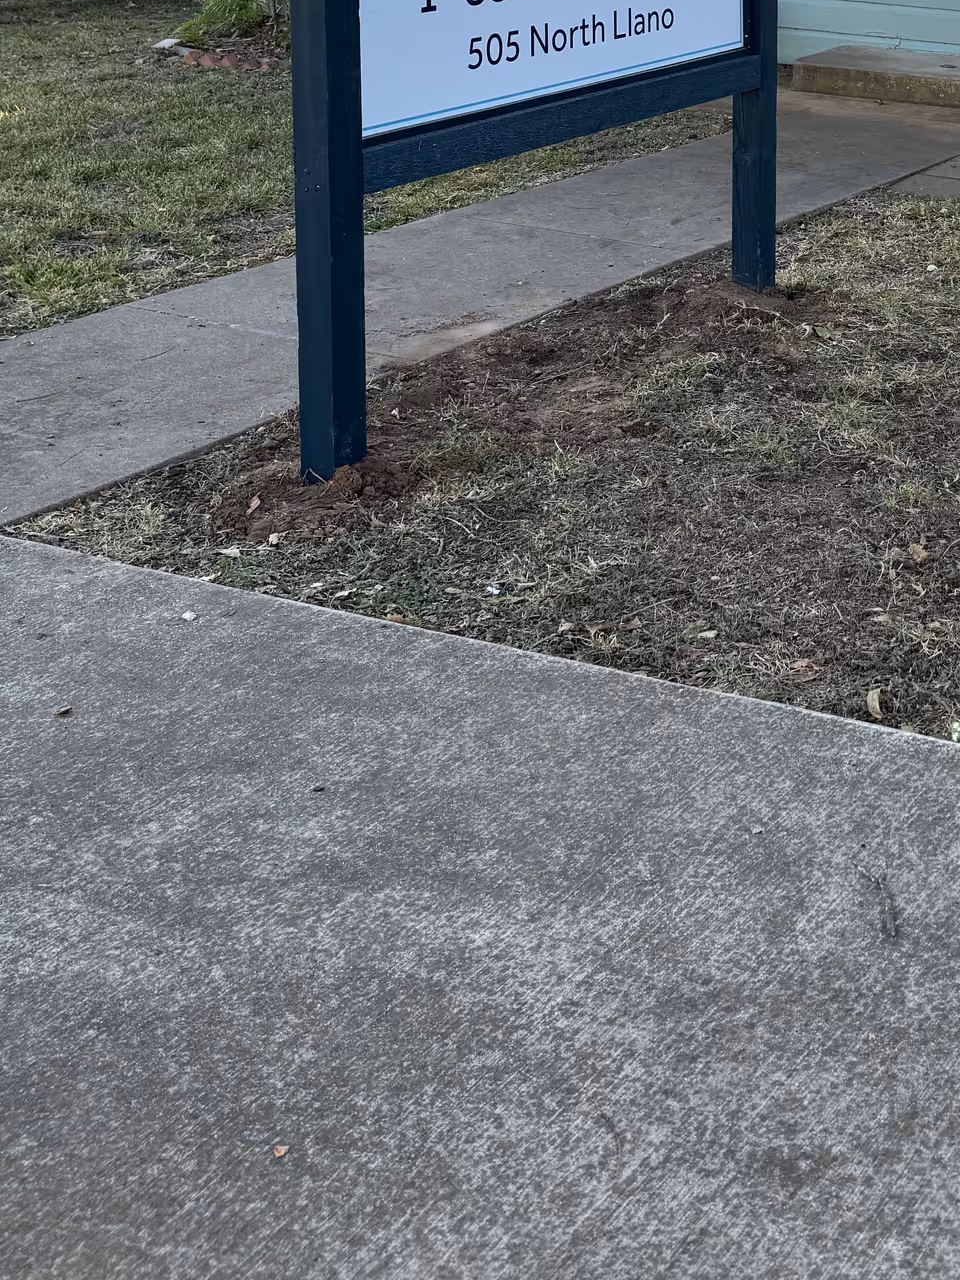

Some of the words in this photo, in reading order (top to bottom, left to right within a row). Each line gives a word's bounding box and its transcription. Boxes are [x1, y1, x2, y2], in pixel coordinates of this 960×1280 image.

[467, 29, 520, 70] 505
[530, 14, 606, 57] North
[613, 7, 675, 40] Llano
